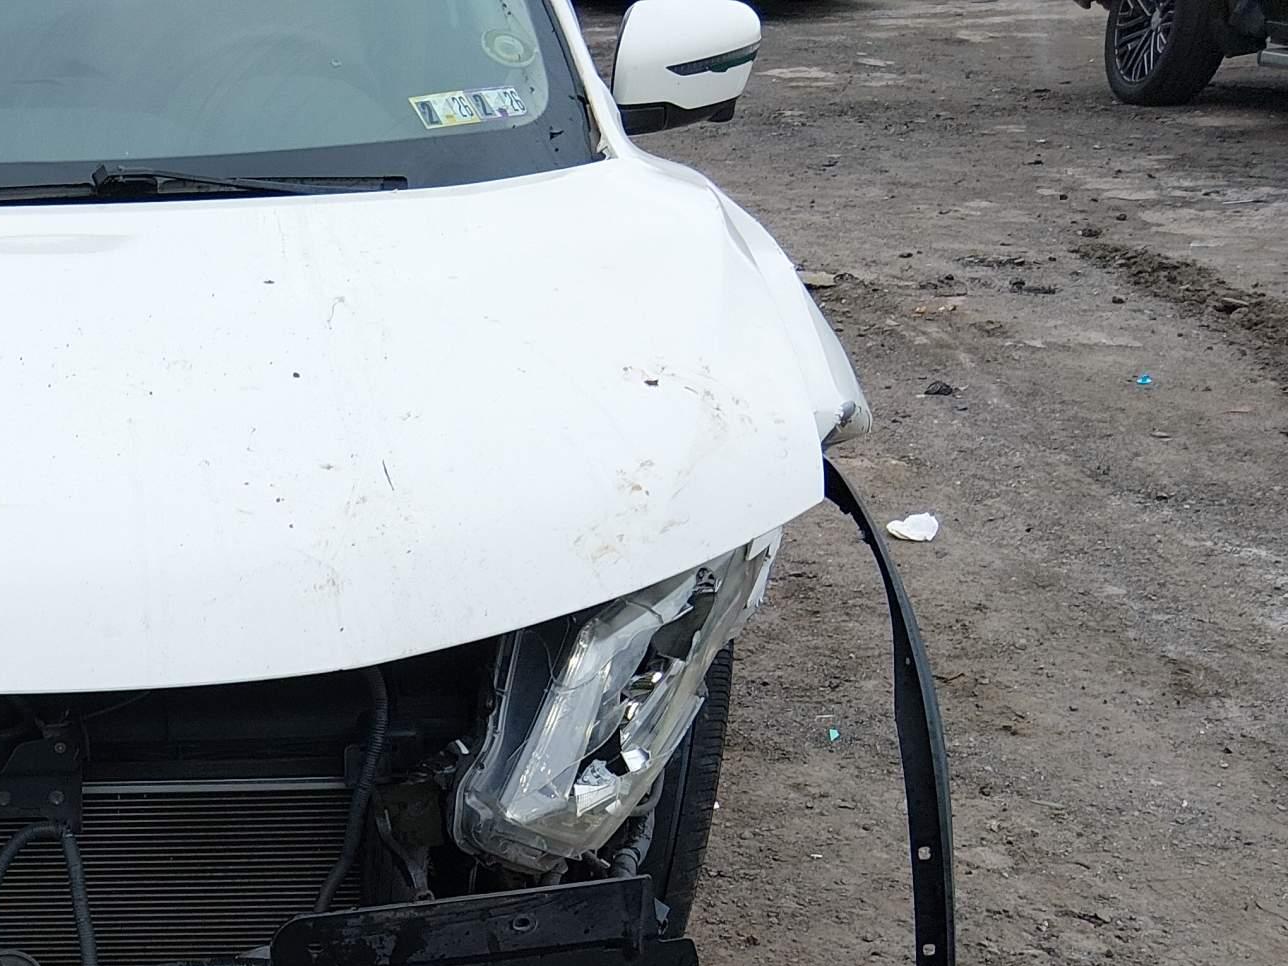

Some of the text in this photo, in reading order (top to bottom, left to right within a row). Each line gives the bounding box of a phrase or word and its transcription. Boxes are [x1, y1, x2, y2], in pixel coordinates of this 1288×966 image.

[420, 96, 474, 125] 2 26
[472, 90, 526, 117] 2 26
